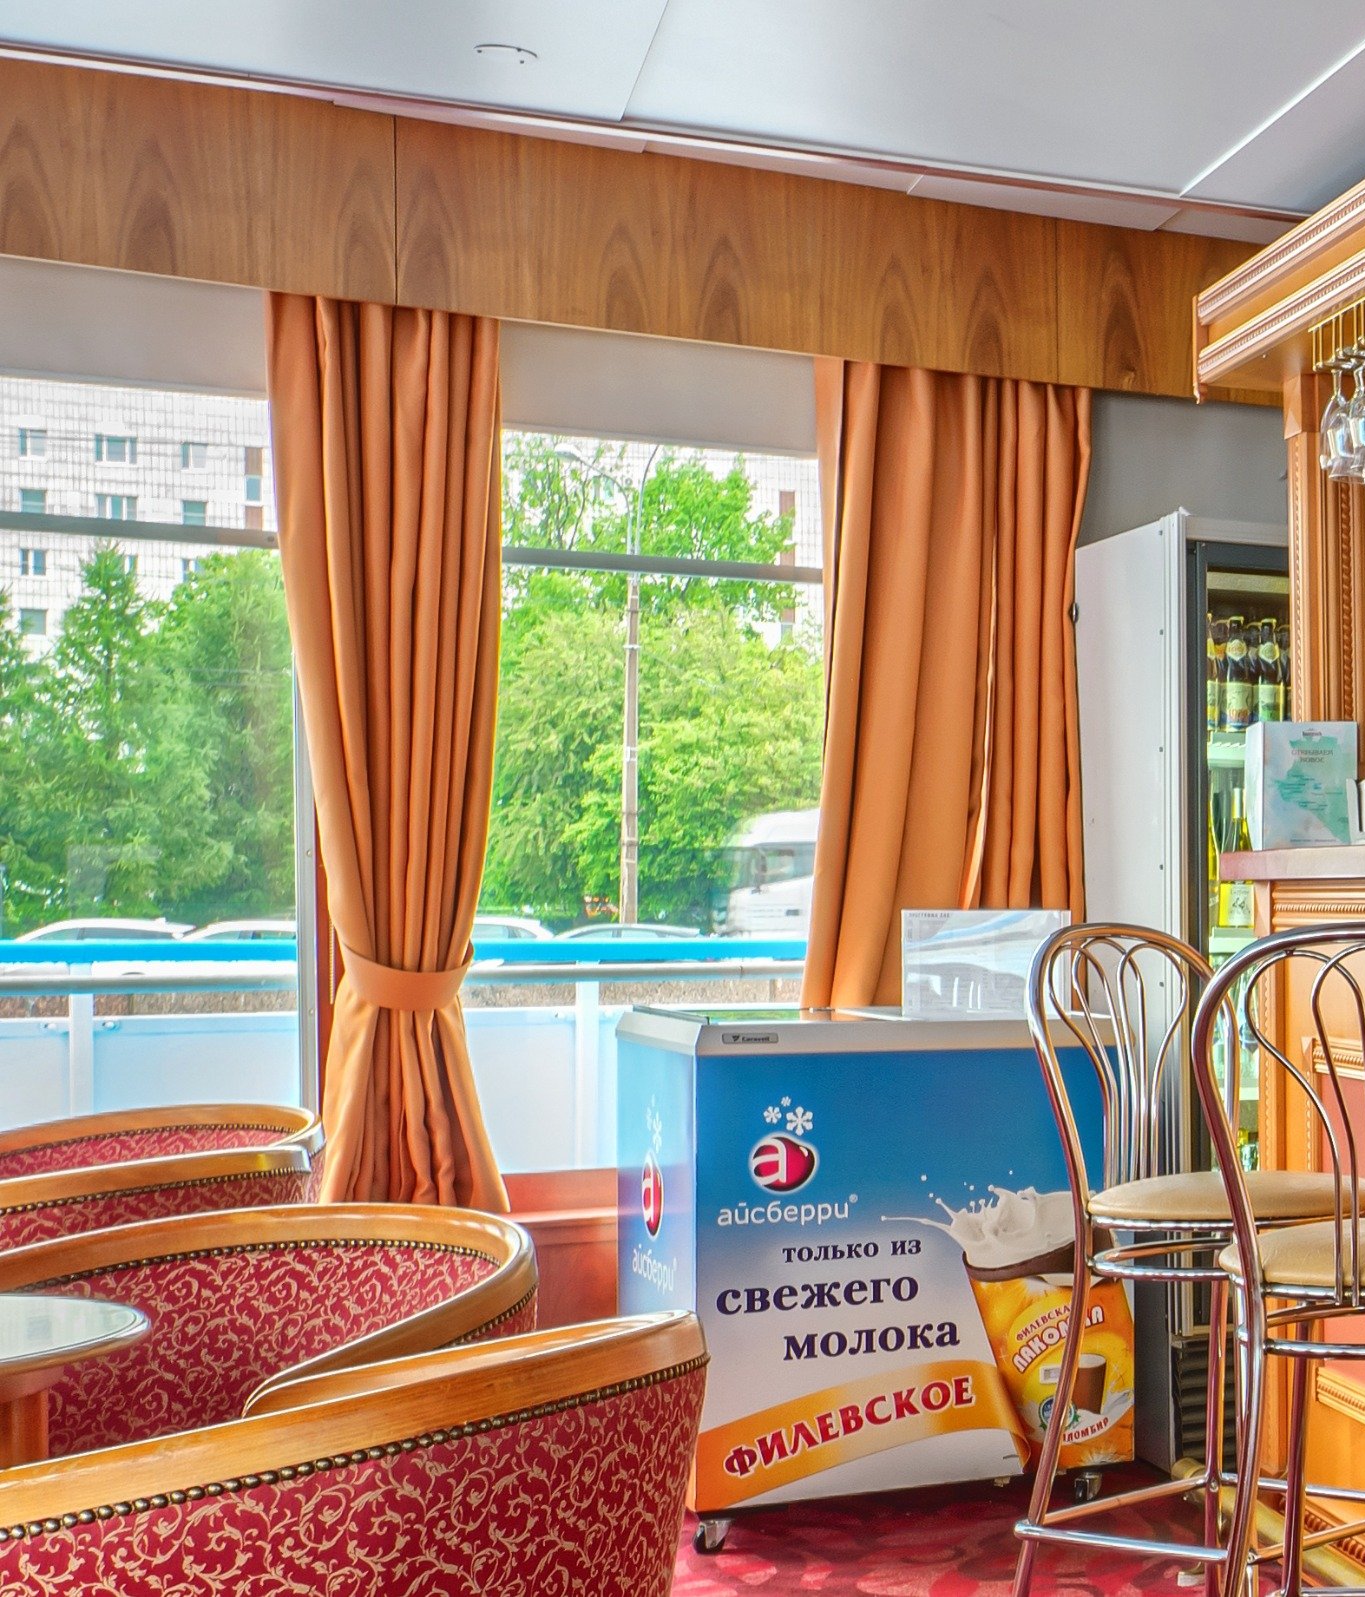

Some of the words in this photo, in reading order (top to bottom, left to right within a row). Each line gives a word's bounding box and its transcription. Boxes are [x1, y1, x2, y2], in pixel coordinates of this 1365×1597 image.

[717, 1201, 849, 1226] айсберри
[782, 1241, 879, 1263] только
[890, 1239, 922, 1256] из
[716, 1274, 919, 1315] свежего
[783, 1321, 960, 1361] молока
[1012, 1305, 1105, 1374] ЛАКОА
[1016, 1304, 1073, 1342] ФИЛЕВСКА
[724, 1377, 974, 1476] ФИЛЕВСКОЕ
